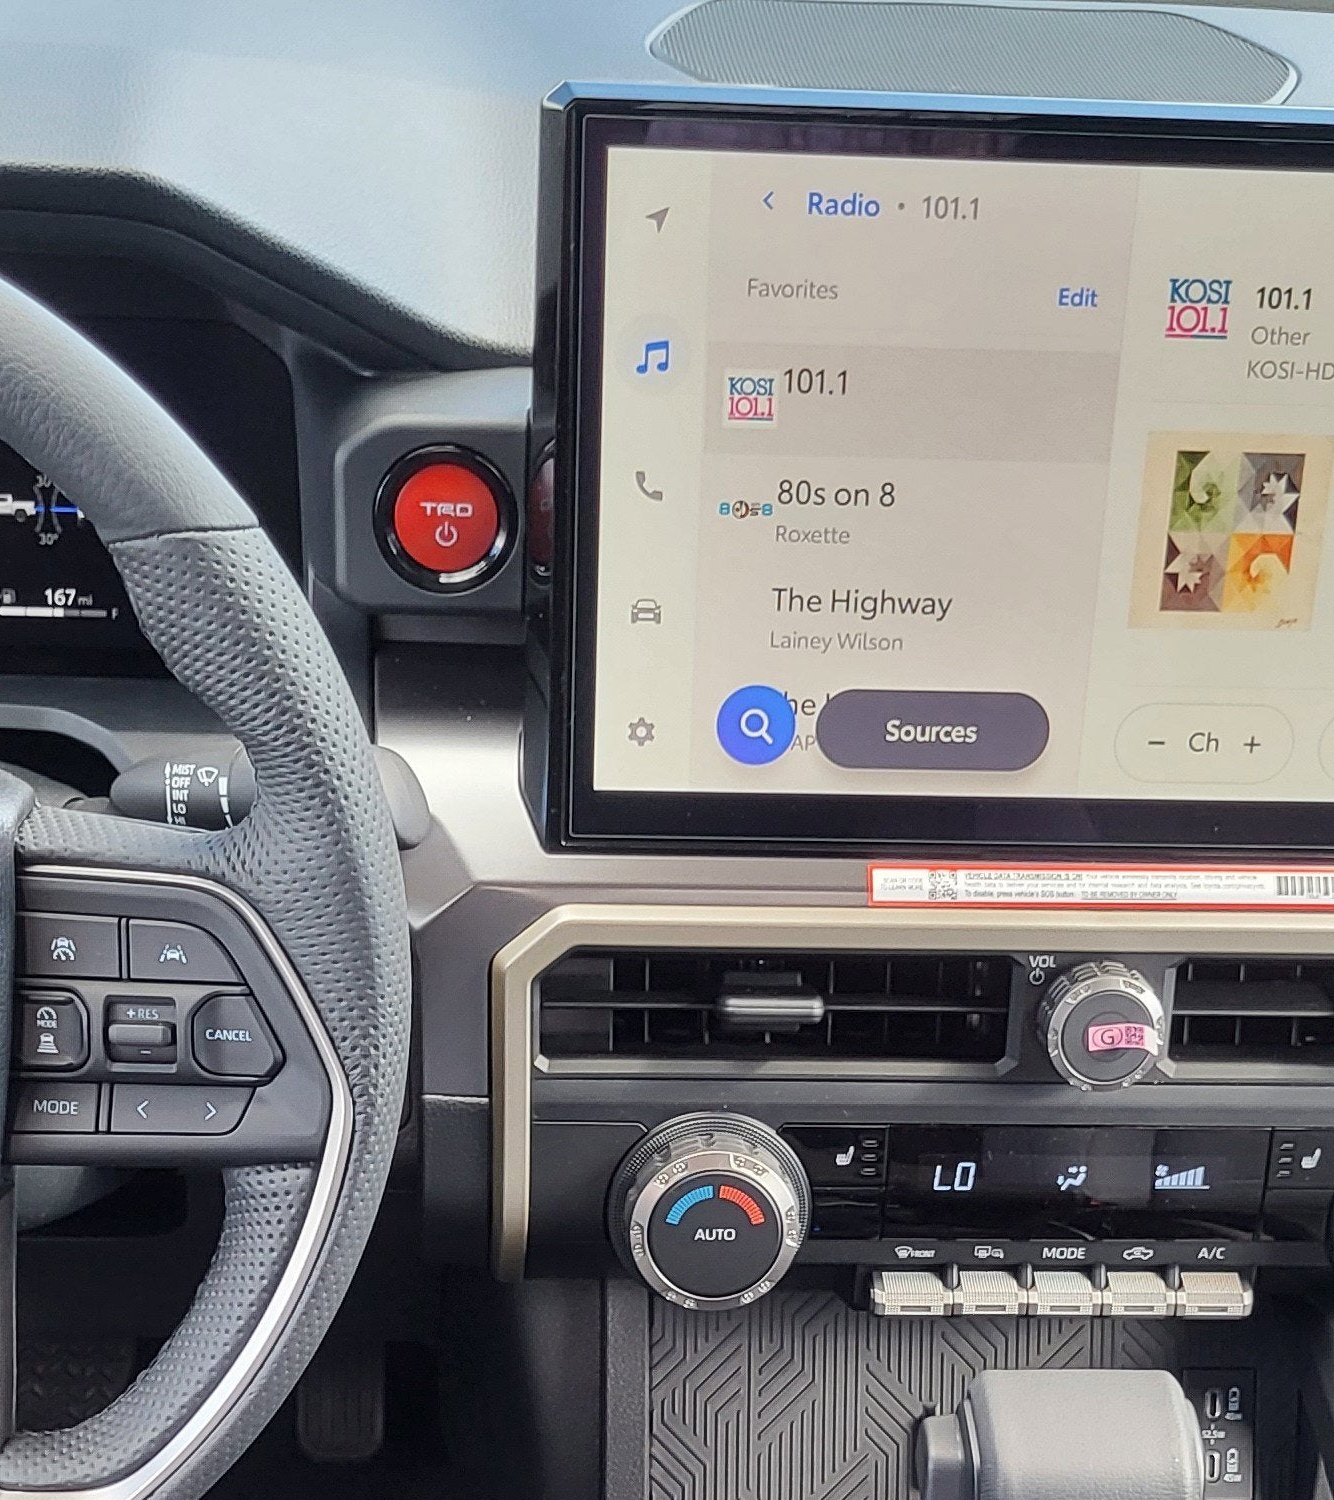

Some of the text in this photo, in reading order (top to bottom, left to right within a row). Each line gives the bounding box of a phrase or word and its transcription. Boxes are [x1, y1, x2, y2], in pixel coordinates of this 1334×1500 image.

[807, 192, 981, 221] Radio 101.1
[747, 277, 838, 300] Favorites
[1058, 287, 1098, 308] Edit
[1169, 279, 1232, 305] KOSI
[1255, 287, 1312, 310] 101.1
[1166, 306, 1228, 334] 101.1
[1251, 326, 1310, 347] Other
[728, 377, 774, 397] KOSI
[782, 368, 849, 396] 101.1
[728, 397, 774, 418] 101.1
[777, 480, 895, 508] 80s on 8
[420, 501, 473, 518] TRD
[775, 524, 850, 545] Roxette
[44, 588, 77, 606] 167
[772, 587, 952, 621] The Highway
[770, 631, 903, 653] Lainey Wilson
[884, 719, 978, 745] Sources
[1188, 733, 1220, 753] Ch
[172, 764, 197, 776] MIST
[171, 777, 191, 789] OFF
[171, 790, 189, 802] INT
[173, 803, 187, 814] LO
[1029, 955, 1057, 968] VOL
[36, 1018, 59, 1029] MODE
[205, 1029, 253, 1043] CANCEL
[33, 1099, 79, 1115] MODE
[932, 1161, 976, 1192] LO
[694, 1228, 736, 1242] AUTO
[1042, 1246, 1086, 1260] MODE
[1197, 1245, 1227, 1261] A/C
